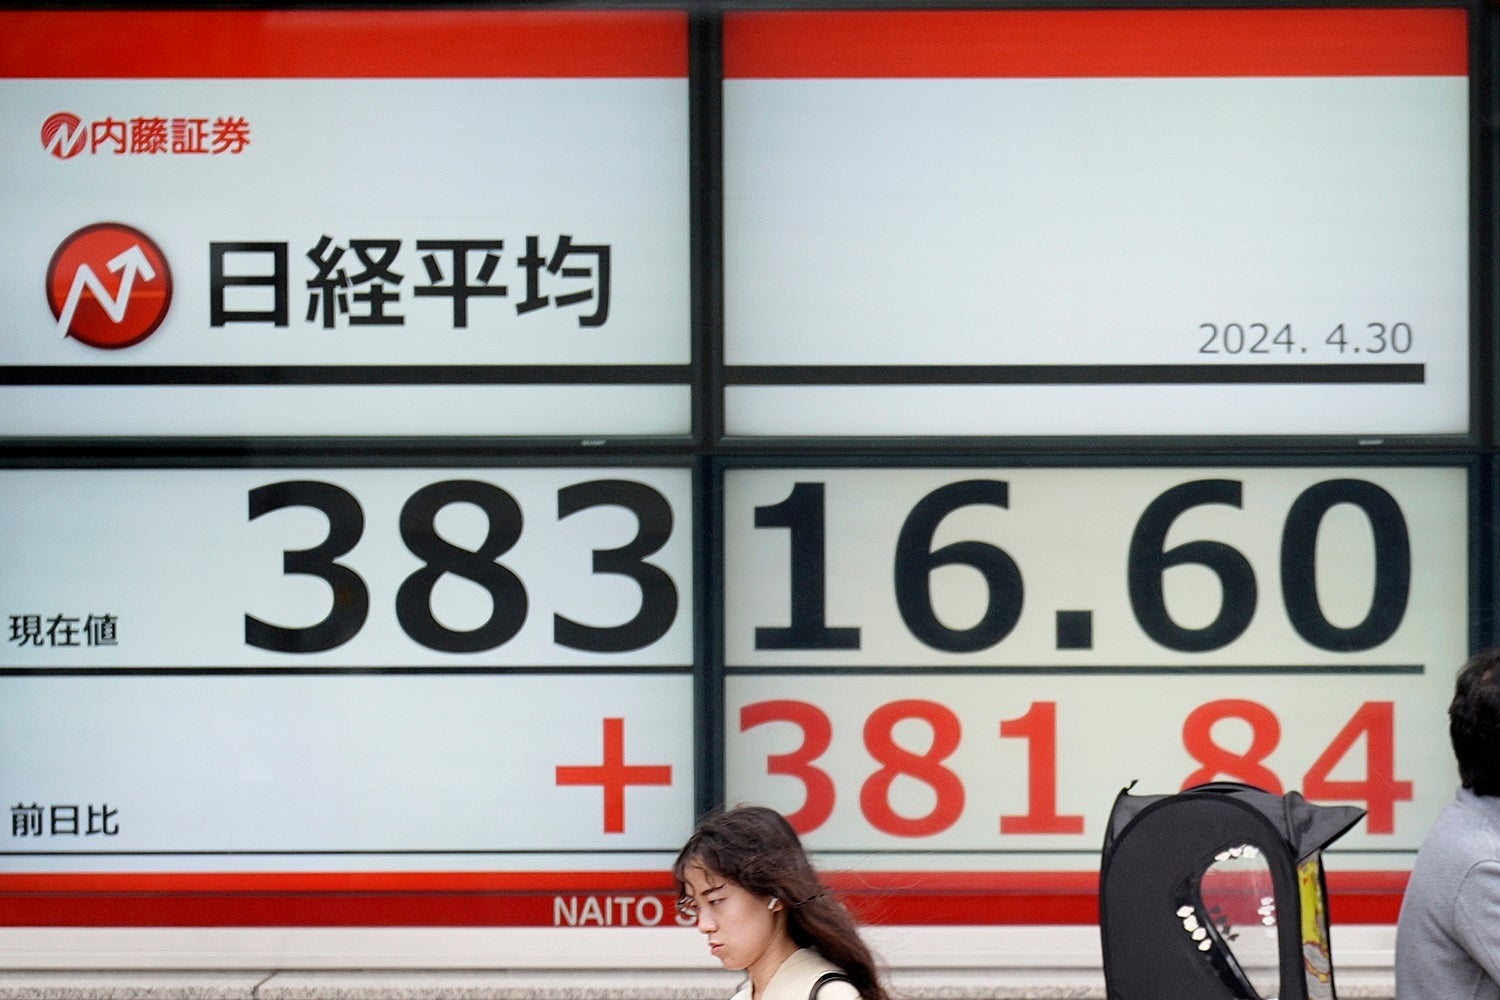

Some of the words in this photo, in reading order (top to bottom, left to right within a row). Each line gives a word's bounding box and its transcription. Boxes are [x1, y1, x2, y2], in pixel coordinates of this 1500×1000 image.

[91, 116, 251, 155] 内藤証券
[209, 234, 612, 330] 日経平均
[8, 613, 119, 647] 現在値
[10, 803, 119, 838] 前日比
[553, 895, 665, 926] NAITO
